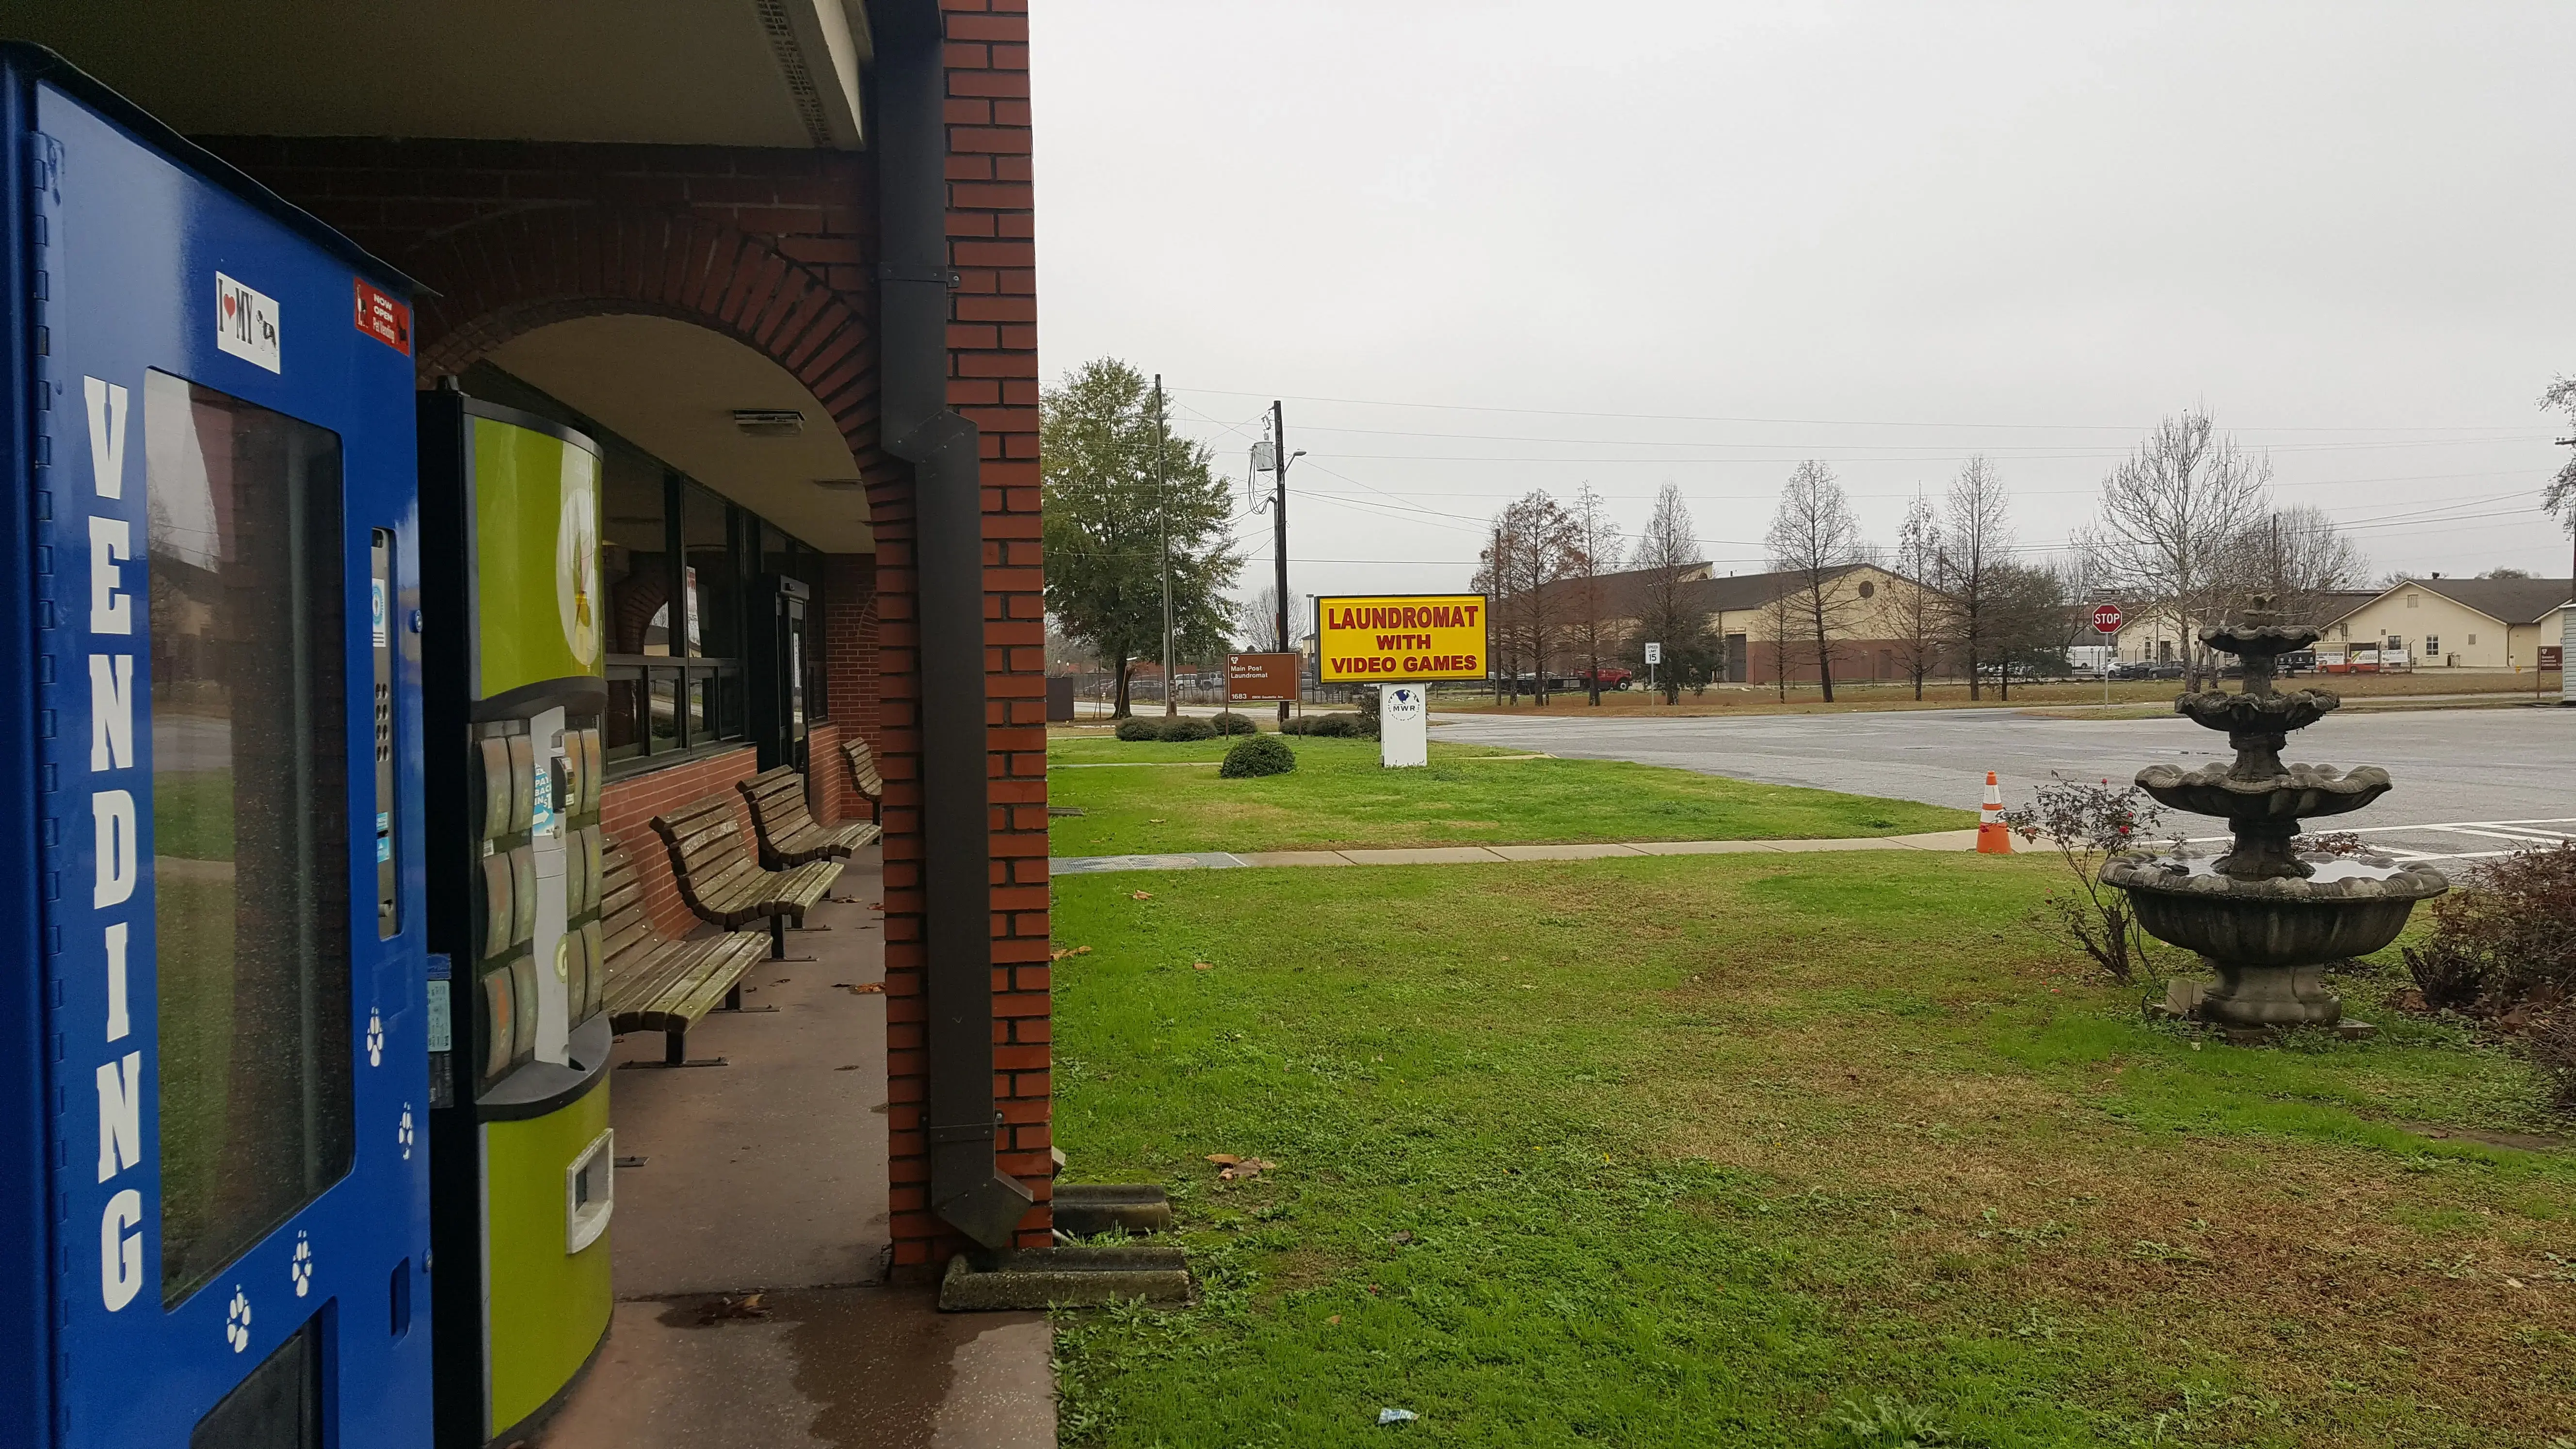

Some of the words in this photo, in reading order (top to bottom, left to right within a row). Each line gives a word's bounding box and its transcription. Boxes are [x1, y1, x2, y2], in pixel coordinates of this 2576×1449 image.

[372, 293, 392, 311] NOW
[218, 278, 224, 332] I
[235, 287, 253, 345] MY
[373, 305, 393, 323] OPEN
[1328, 605, 1479, 629] LAUNDROMAT
[2094, 613, 2120, 624] STOP
[1376, 634, 1431, 650] WITH
[1331, 656, 1397, 674] VIDEO
[1403, 655, 1477, 672] GAMES
[535, 776, 552, 788] PAY
[534, 796, 544, 805] IN
[83, 374, 143, 1313] VENDING
